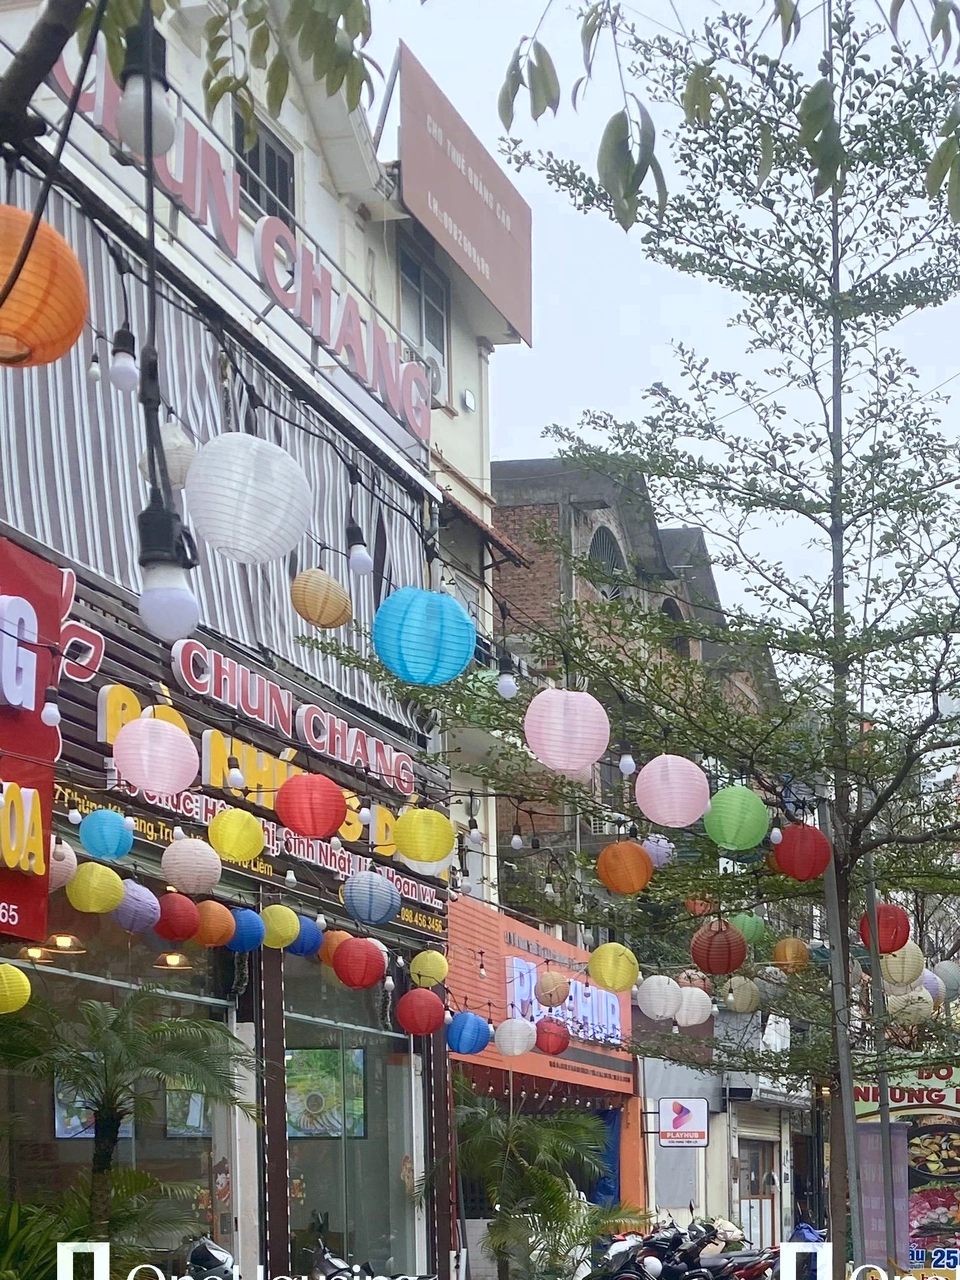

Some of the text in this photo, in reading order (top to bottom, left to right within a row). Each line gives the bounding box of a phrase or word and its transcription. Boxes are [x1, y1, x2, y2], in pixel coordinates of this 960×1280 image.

[254, 215, 431, 441] CHANG
[171, 638, 416, 797] CHUN CHANG
[666, 1131, 699, 1139] PLAYHUB
